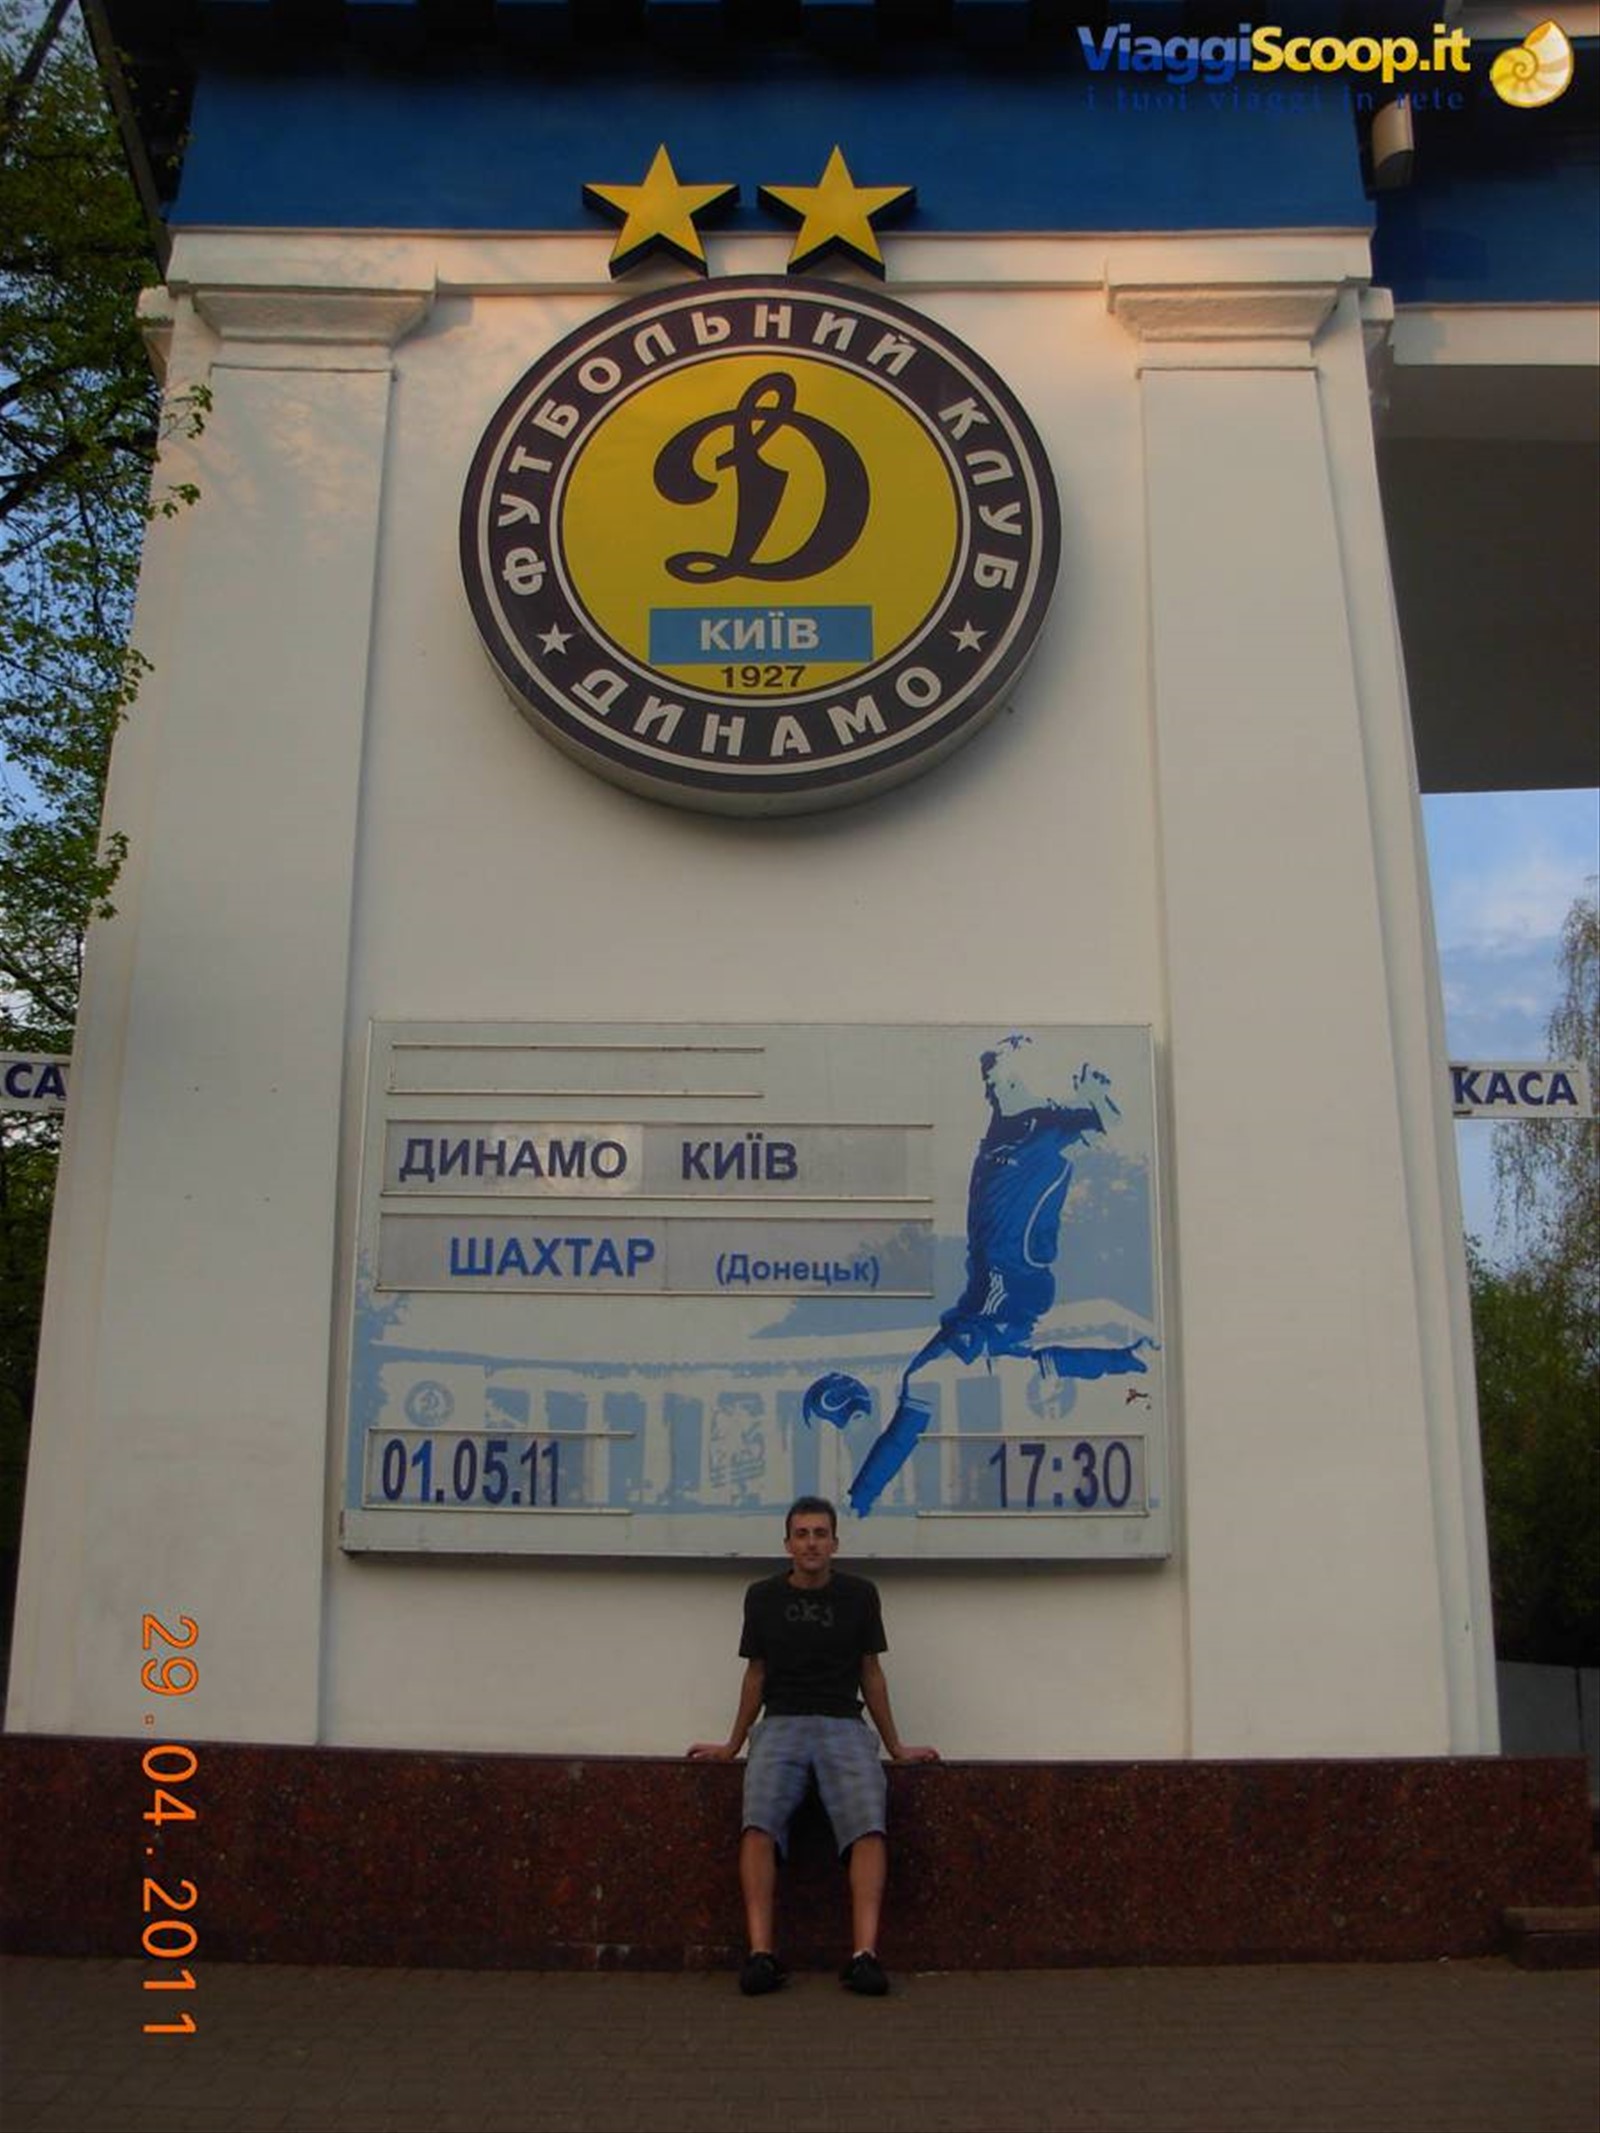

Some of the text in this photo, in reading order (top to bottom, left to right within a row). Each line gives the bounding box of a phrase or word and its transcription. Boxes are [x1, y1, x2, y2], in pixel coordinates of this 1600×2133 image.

[498, 303, 1023, 596] ФУТБОЛЬНИЙ КЛУБ
[700, 610, 820, 651] КИЇВ
[721, 664, 807, 689] 1927
[570, 666, 942, 758] ДИНАМО
[1452, 1070, 1579, 1106] КАСА
[399, 1132, 798, 1183] ДИНАМО КИЇВ
[450, 1236, 881, 1287] ШАХТАР (Донецьк)
[382, 1437, 561, 1507] 01.05.11
[988, 1440, 1132, 1509] 17:30
